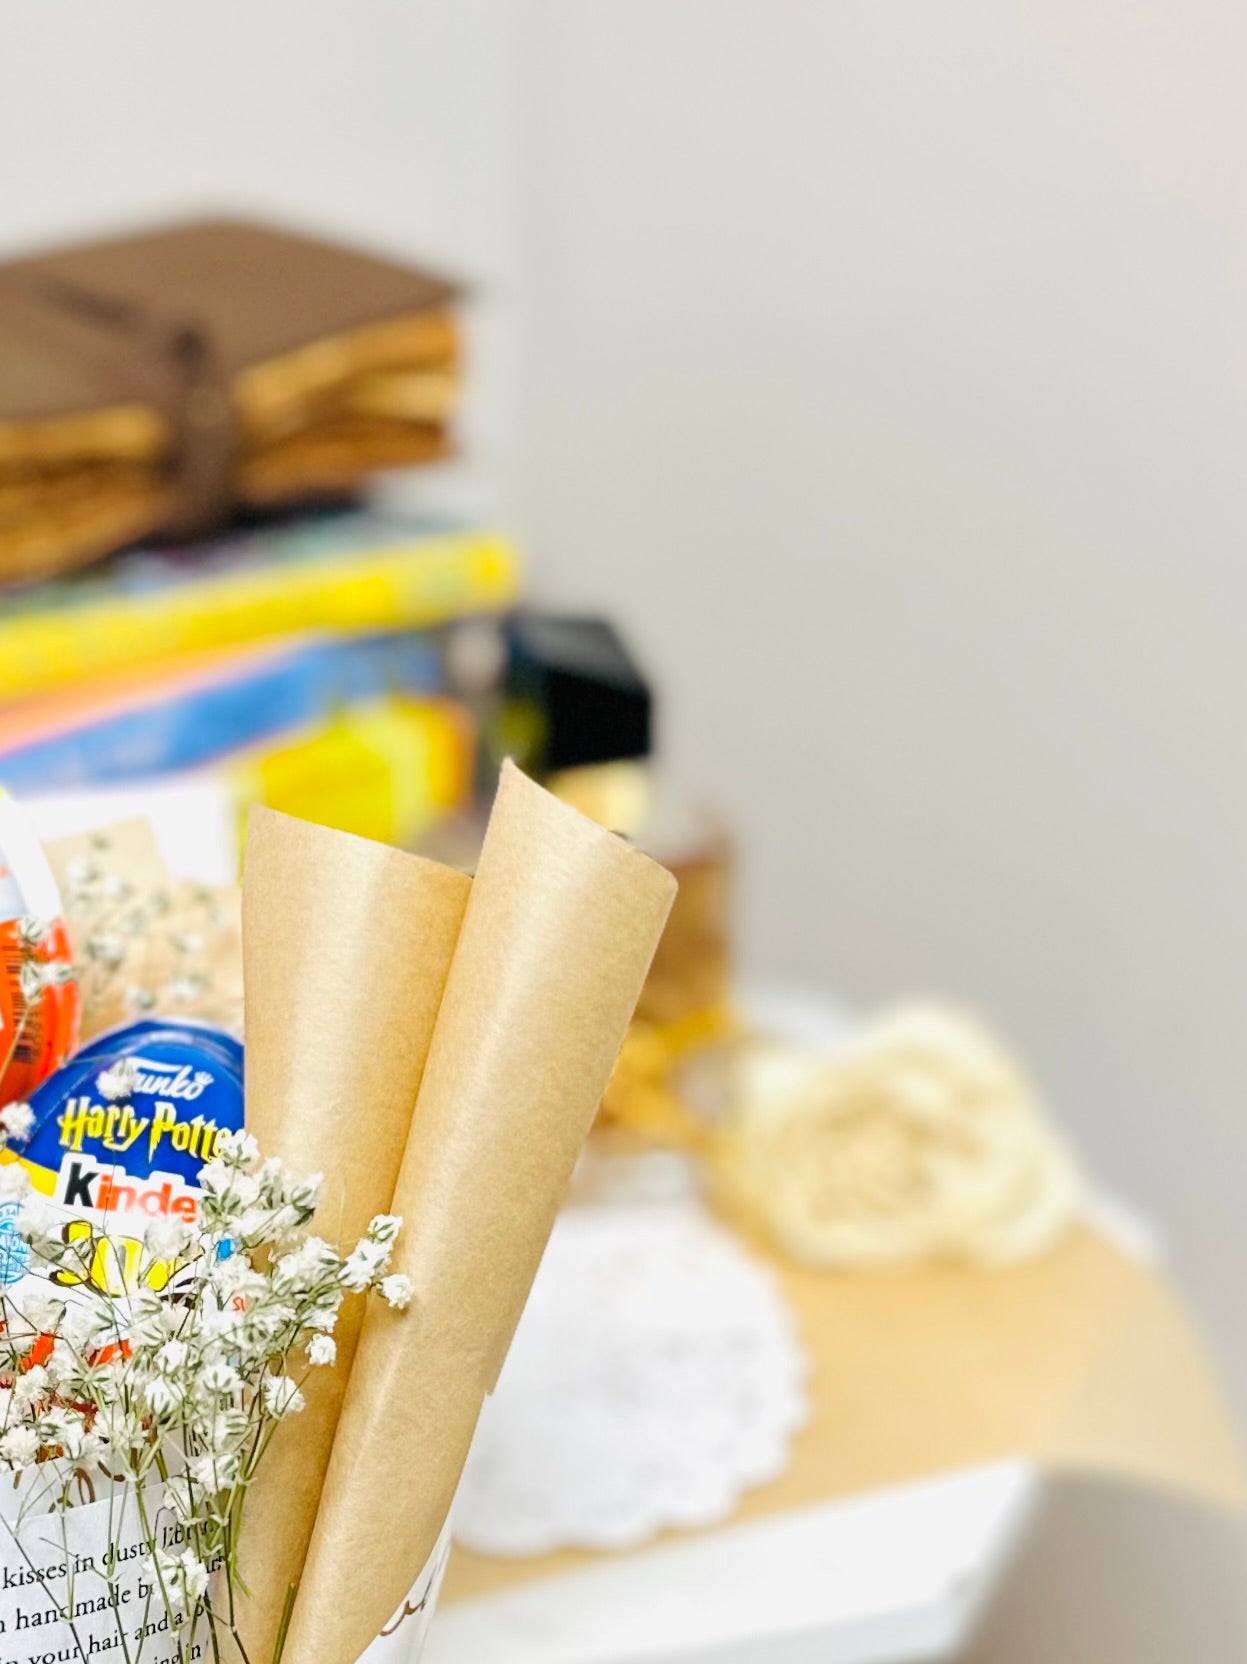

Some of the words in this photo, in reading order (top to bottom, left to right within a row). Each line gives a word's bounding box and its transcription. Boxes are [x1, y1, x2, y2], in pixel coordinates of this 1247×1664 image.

[58, 1096, 150, 1152] Harry
[148, 1101, 232, 1164] Potte
[64, 1161, 198, 1224] Kinde
[2, 1566, 67, 1590] kisses
[74, 1553, 94, 1574] in
[88, 1630, 129, 1656] hair
[134, 1611, 169, 1640] and
